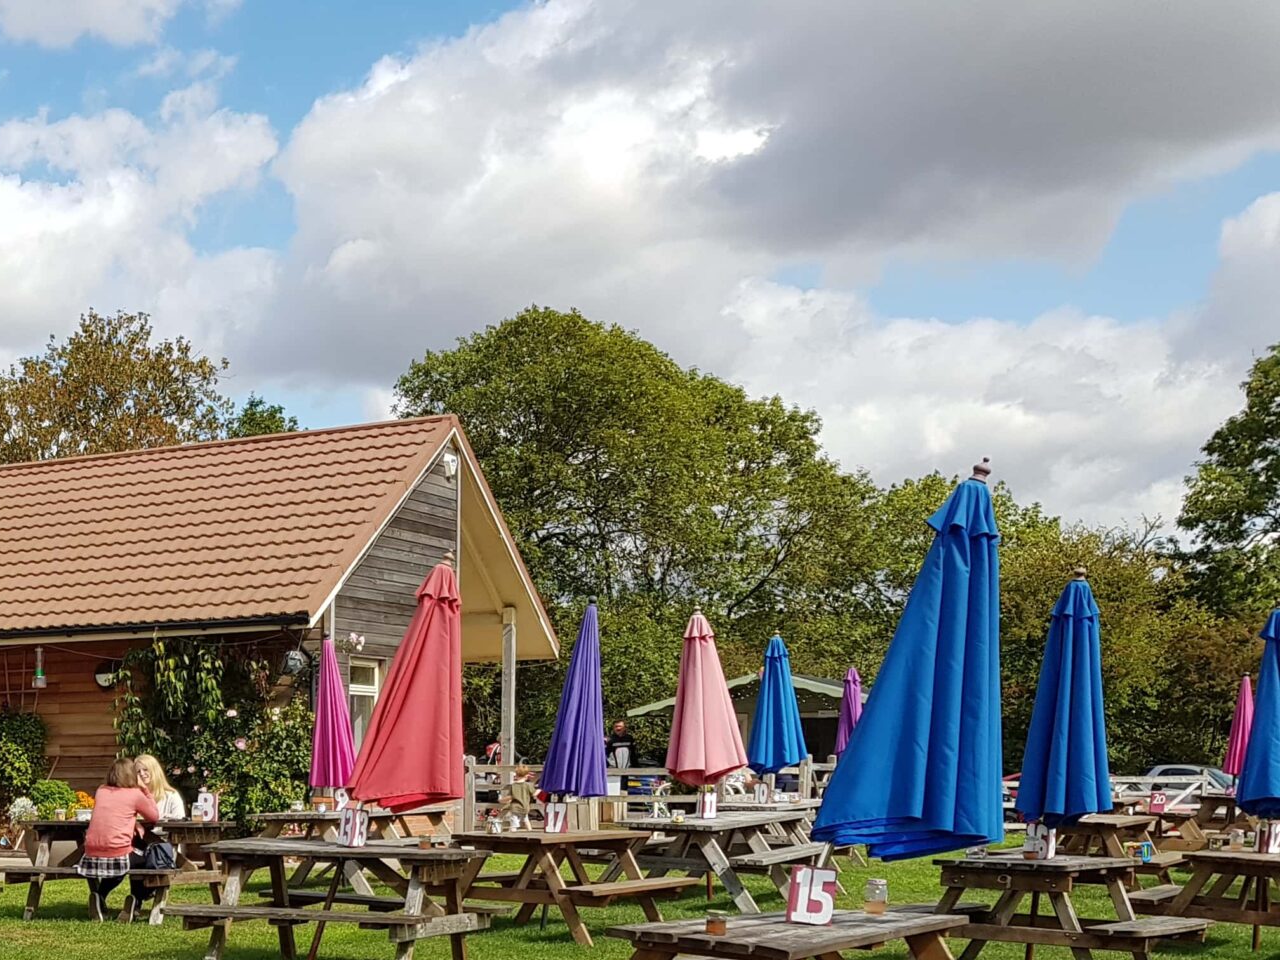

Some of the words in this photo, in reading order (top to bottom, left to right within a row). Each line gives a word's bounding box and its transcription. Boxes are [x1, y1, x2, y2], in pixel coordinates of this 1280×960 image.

[335, 788, 349, 811] 9
[754, 783, 768, 804] 10
[1152, 793, 1166, 805] 20
[198, 793, 214, 821] 8
[546, 803, 567, 832] 17
[791, 868, 836, 924] 15
